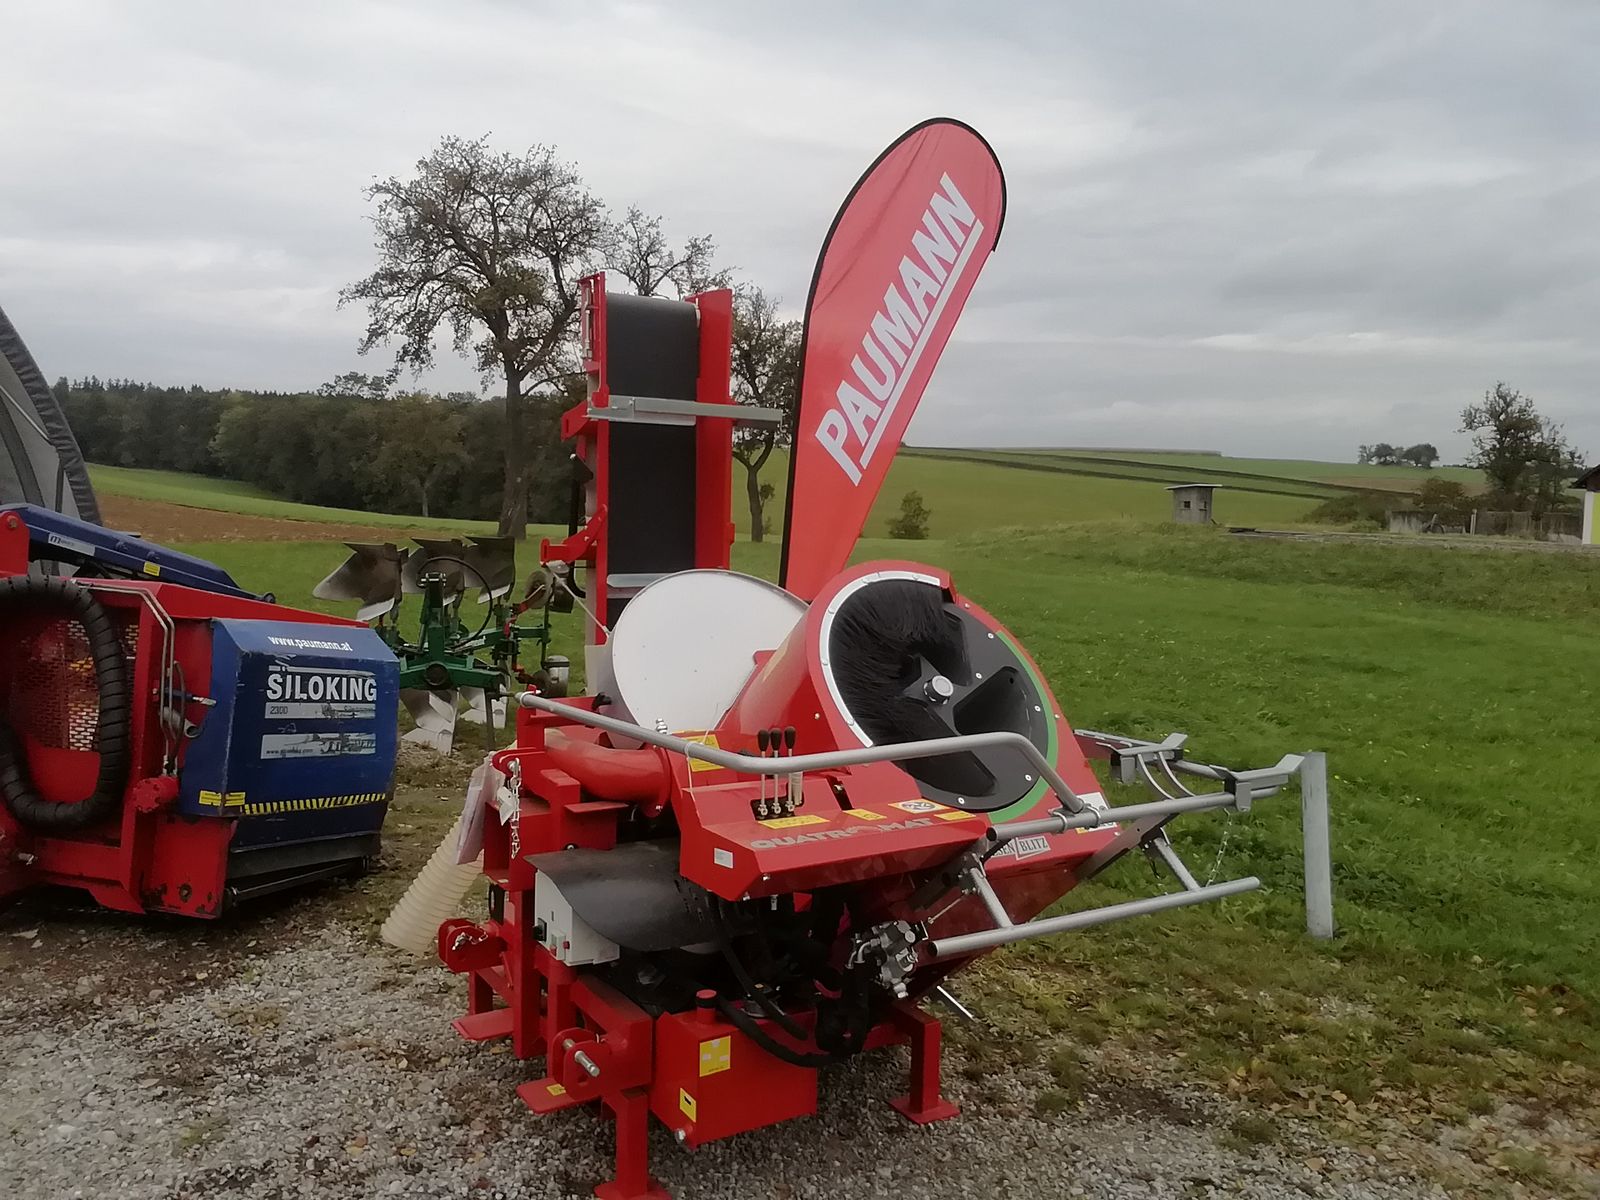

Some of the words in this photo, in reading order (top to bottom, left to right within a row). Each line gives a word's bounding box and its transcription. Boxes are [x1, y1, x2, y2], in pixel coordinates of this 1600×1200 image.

[815, 171, 977, 487] PAUMANN
[268, 636, 353, 652] www.paumann.at
[266, 673, 377, 701] SILOKING
[1019, 837, 1048, 852] BLITZ
